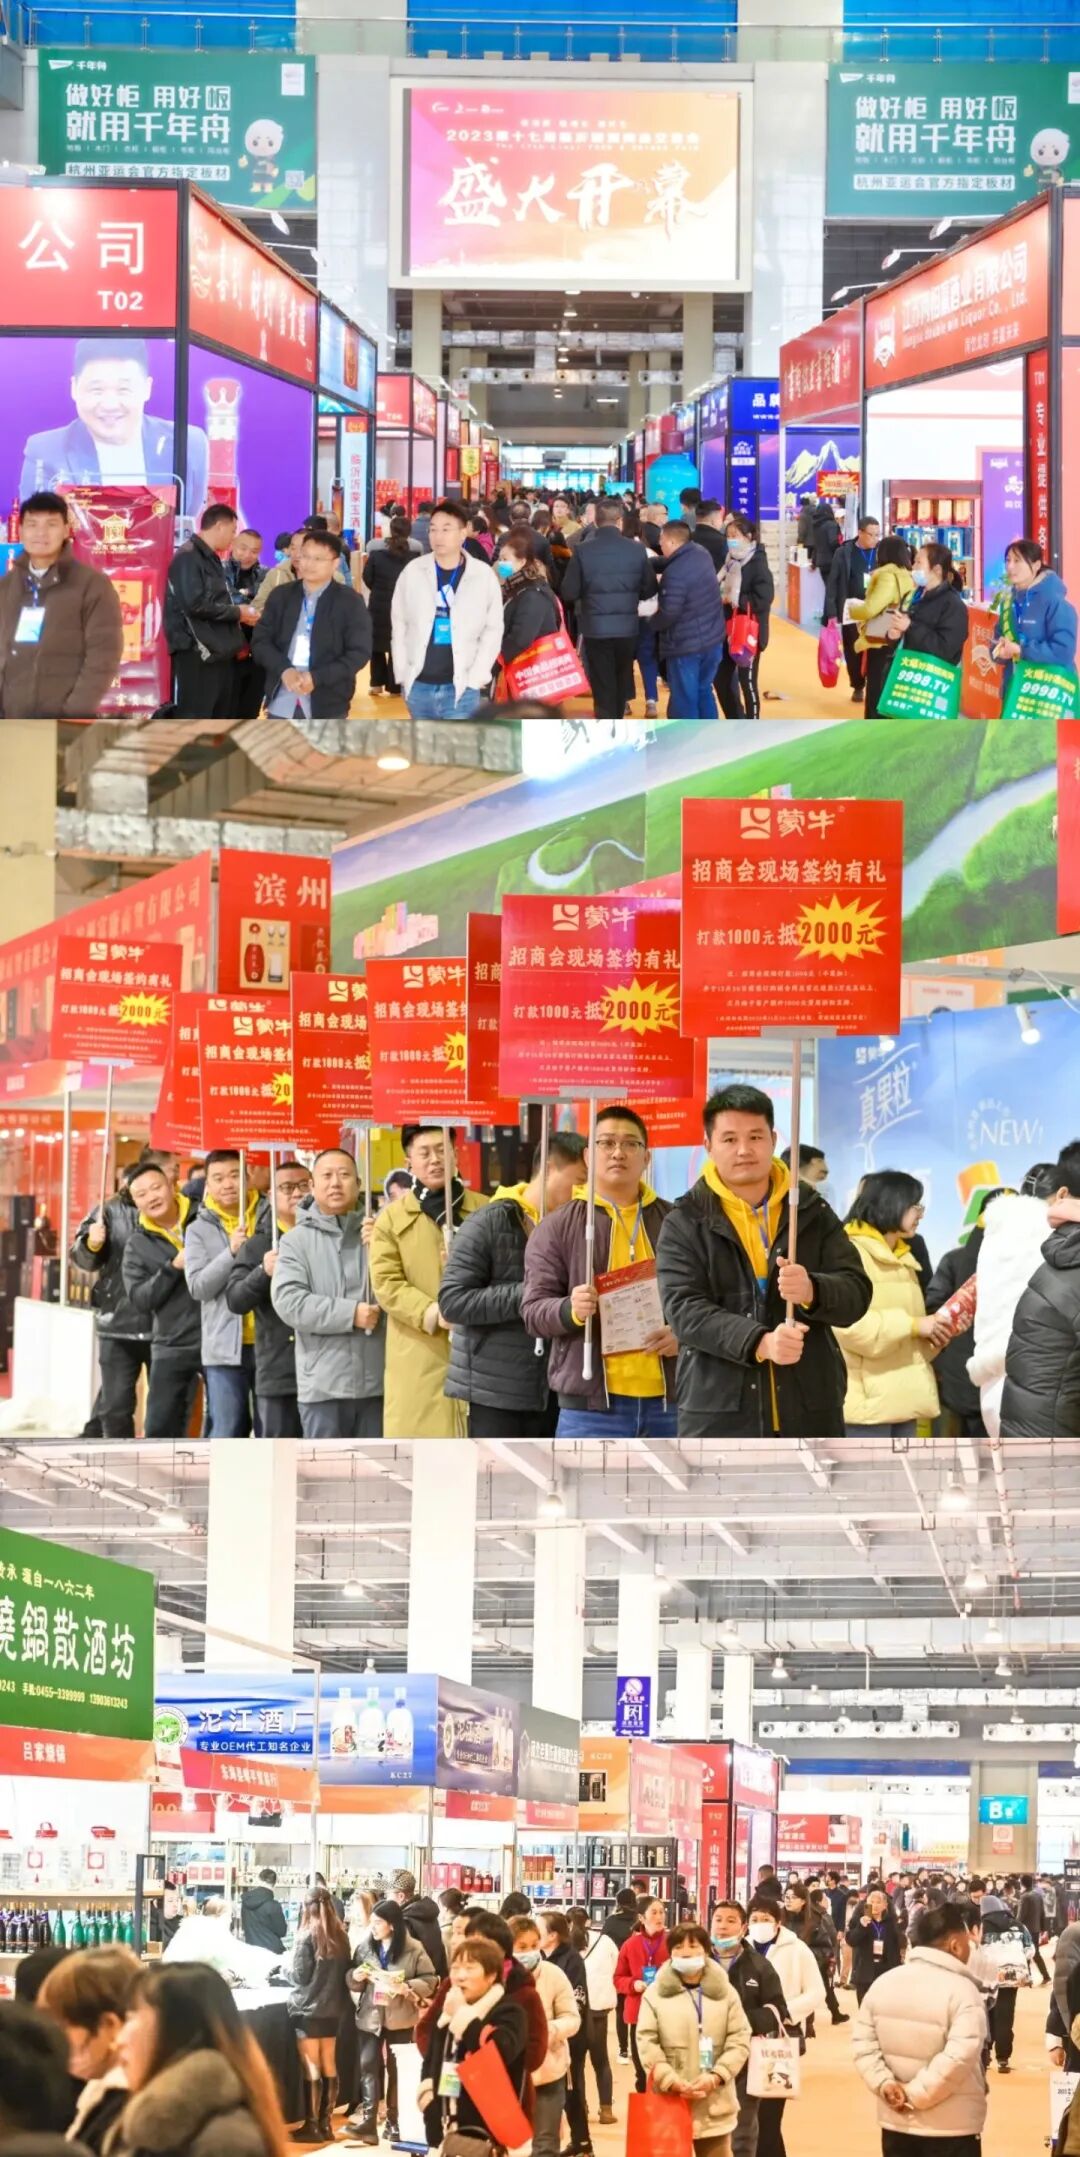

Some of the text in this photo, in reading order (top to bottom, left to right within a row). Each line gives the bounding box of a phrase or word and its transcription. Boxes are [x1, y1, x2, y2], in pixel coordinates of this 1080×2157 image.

[66, 83, 231, 111] 做好柜 用好板
[855, 96, 1017, 121] 做好柜 用好板
[66, 110, 230, 144] 就用千年舟
[855, 123, 1016, 154] 就用千年舟
[856, 176, 1013, 190] 杭州亚运会官方指定板材
[437, 155, 694, 241] 盛大开幕
[18, 220, 145, 275] 公司
[97, 290, 144, 311] T02
[897, 670, 950, 694] 9998.TV
[1020, 681, 1074, 707] 9998.TV
[777, 808, 836, 840] 蒙牛
[691, 857, 887, 884] 招商会现场签约有礼
[253, 872, 328, 911] 滨州
[584, 905, 636, 932] 蒙牛
[696, 920, 875, 947] 打款1000元抵2000元
[110, 944, 144, 963] 蒙牛
[508, 945, 681, 970] 招商会现场签约有礼
[60, 967, 172, 988] 招商会现场签约有礼
[427, 965, 466, 987] 蒙牛
[298, 1010, 368, 1030] 招商会现场
[513, 1000, 672, 1021] 打款1000元抵2000元
[256, 1017, 292, 1037] 蒙牛
[858, 1060, 913, 1141] 真果粒
[199, 1708, 315, 1735] 沱江酒厂
[199, 1740, 312, 1753] 专业OEM代工知名企业
